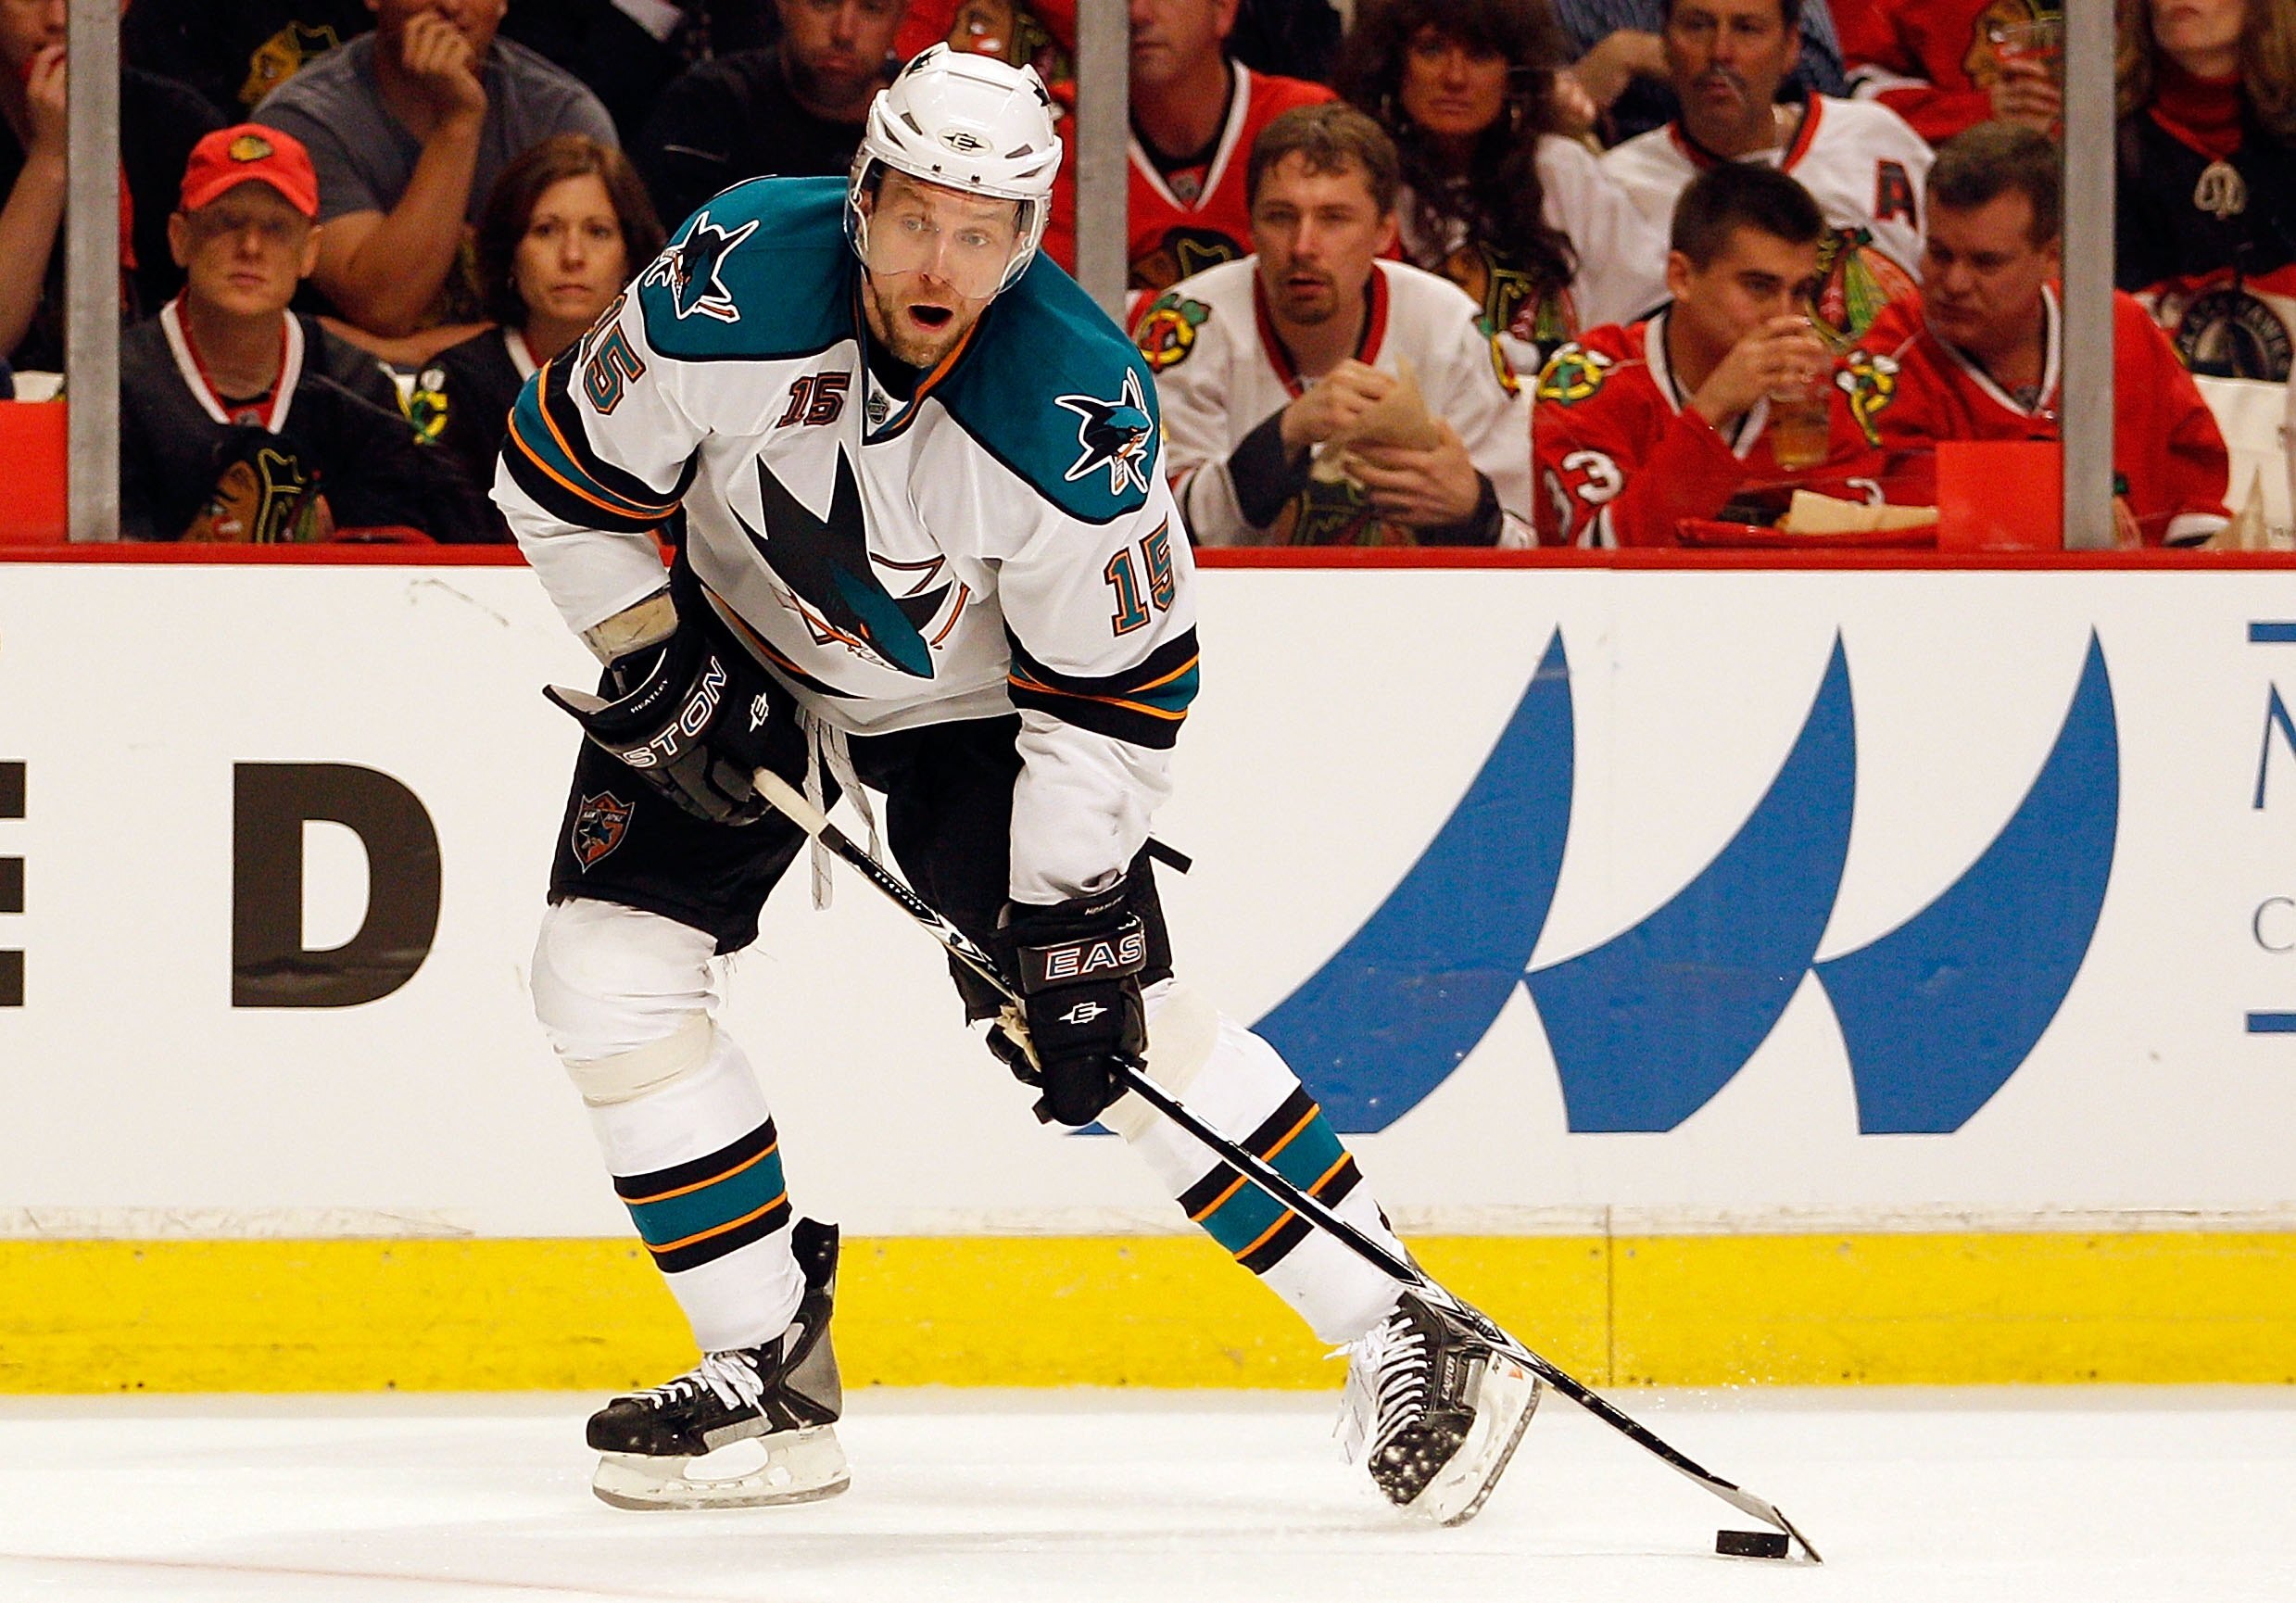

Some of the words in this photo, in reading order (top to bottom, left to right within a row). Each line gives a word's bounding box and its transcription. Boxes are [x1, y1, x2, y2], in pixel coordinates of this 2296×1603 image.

[1875, 160, 1919, 232] A
[776, 372, 852, 428] 15
[1104, 511, 1175, 637] 15
[630, 678, 668, 713] HEATLEY
[1045, 933, 1143, 980] EAS
